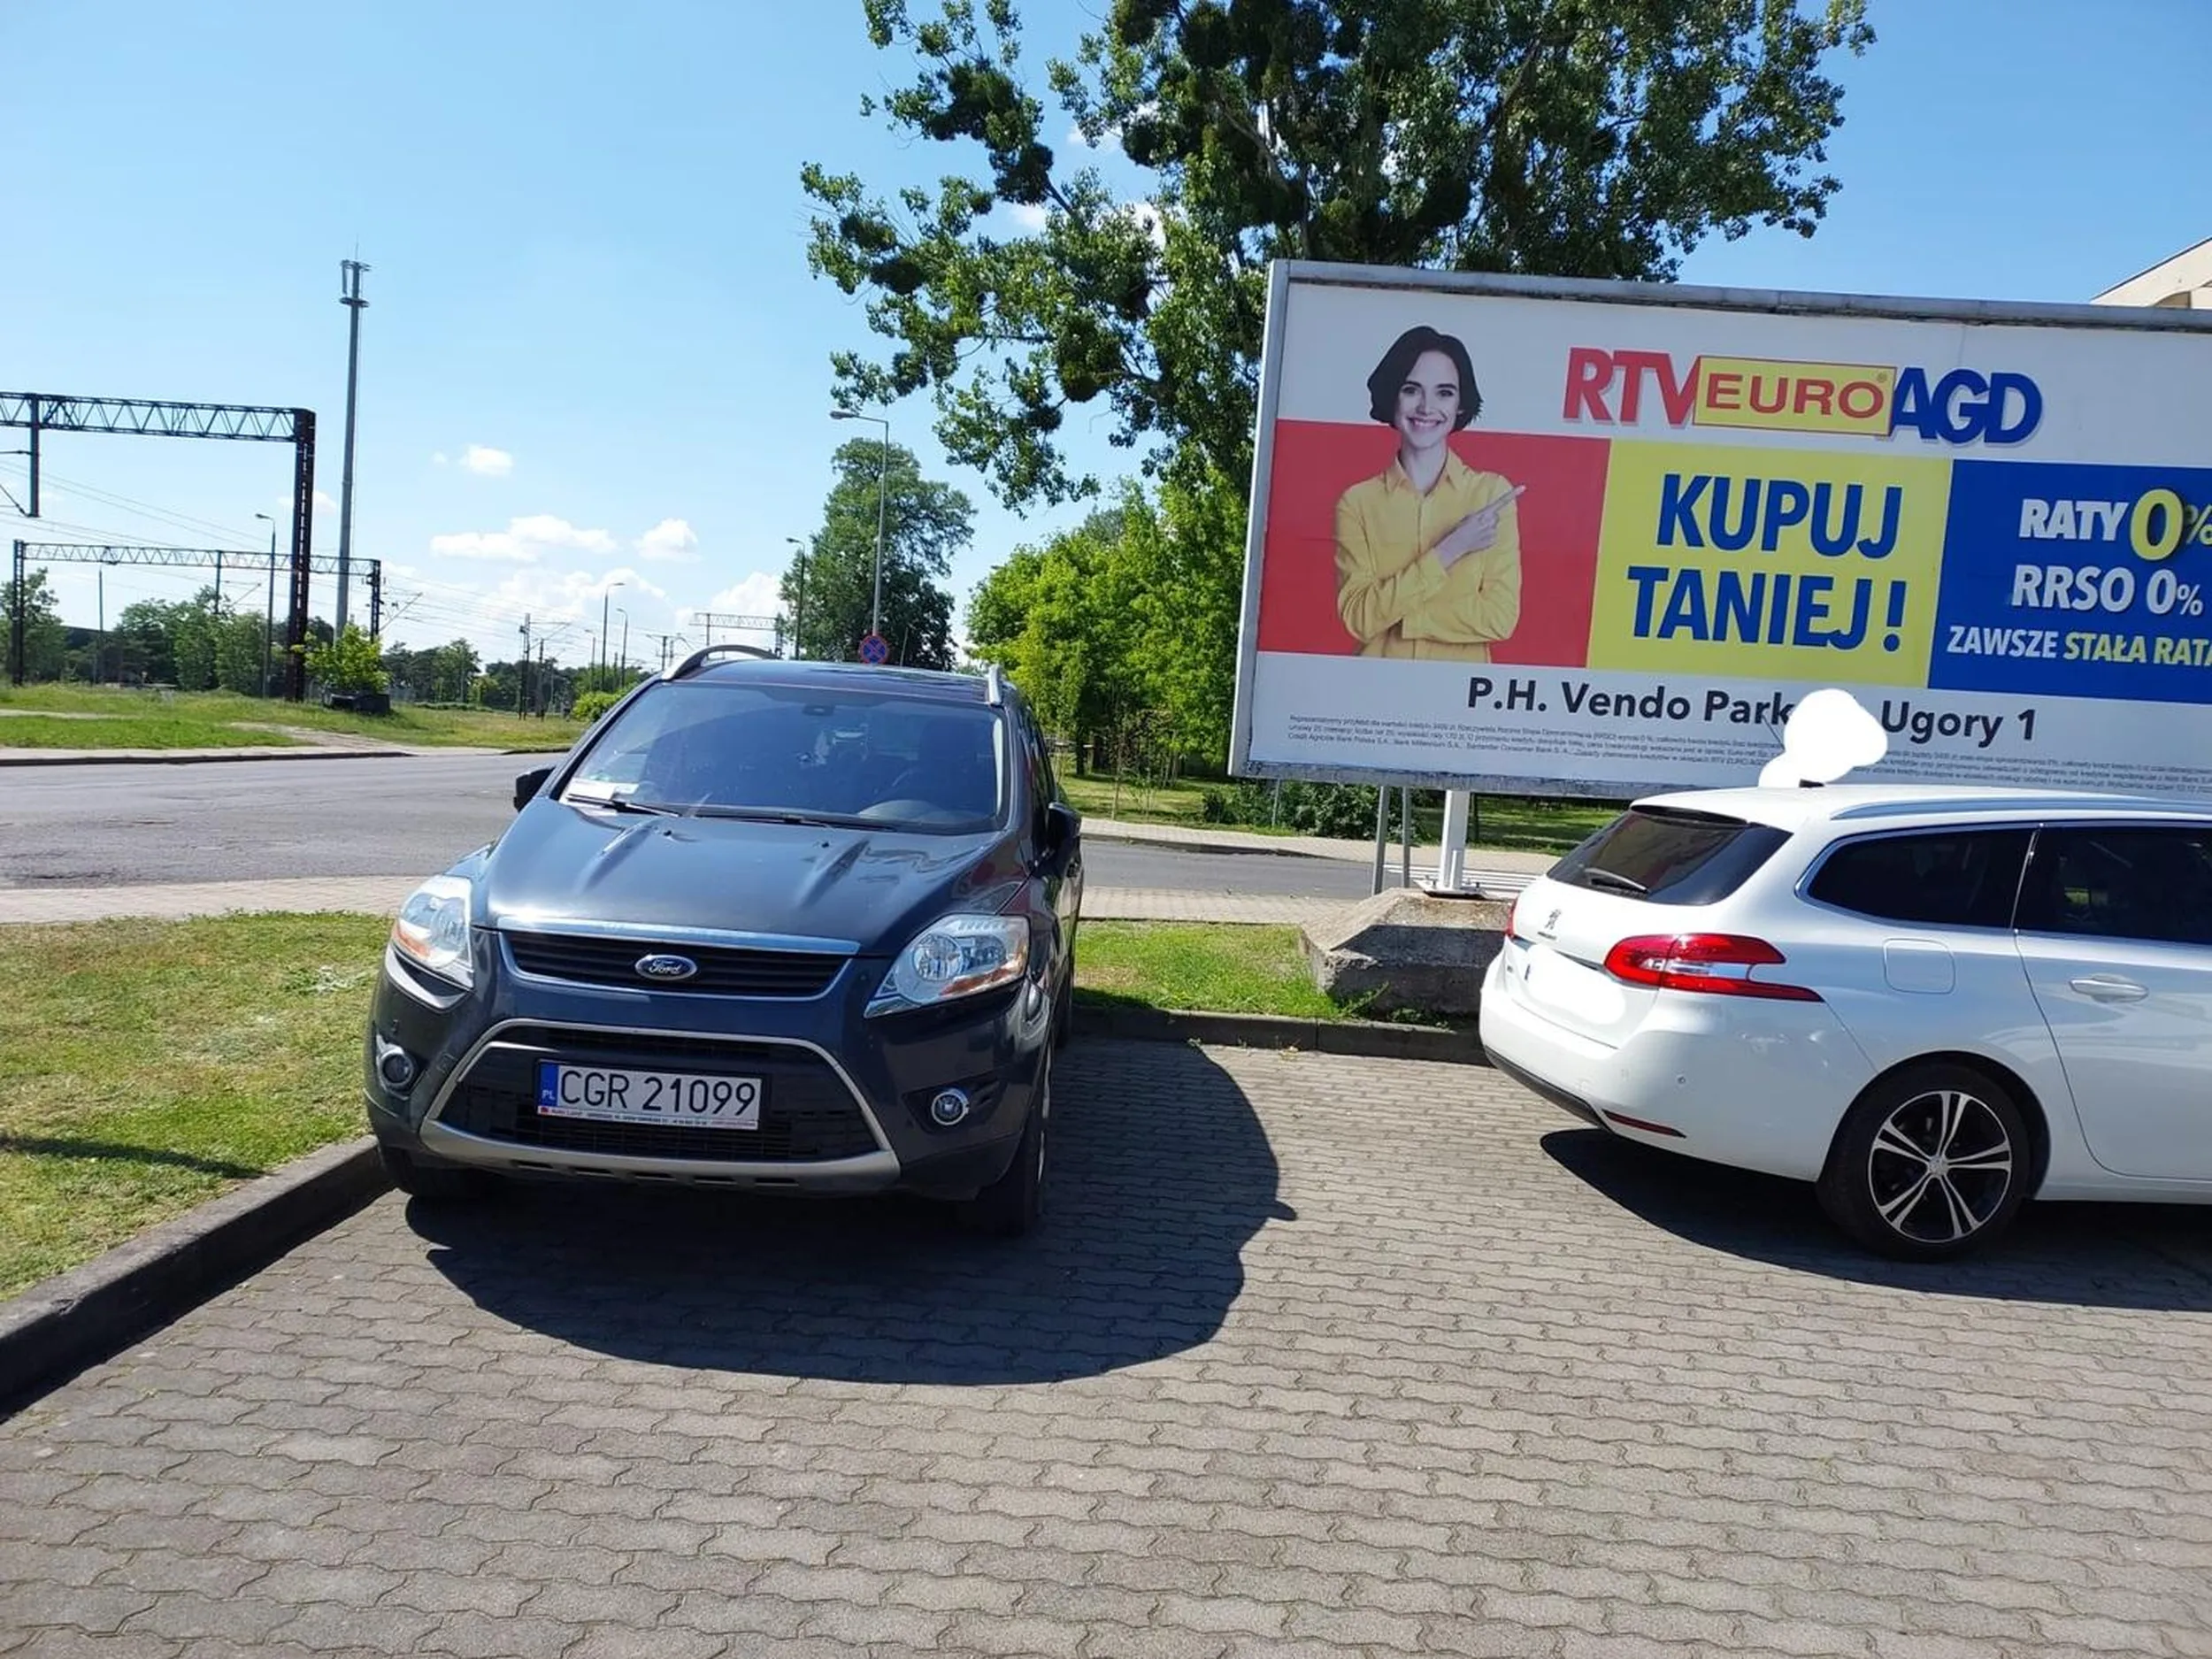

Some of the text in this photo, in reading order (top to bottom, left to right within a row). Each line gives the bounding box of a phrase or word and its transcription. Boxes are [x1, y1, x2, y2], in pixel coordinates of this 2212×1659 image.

[1563, 347, 2043, 444] RTV EURO AGD
[1656, 472, 1903, 559] KUPUJ
[2018, 498, 2129, 541] RATY
[1626, 565, 1908, 653] TANIEJ!
[2010, 564, 2204, 616] RRSO 0%
[1947, 625, 2059, 658] ZAWSZE
[2063, 630, 2147, 664] STAŁA
[1467, 676, 1548, 713] P.H.
[1561, 680, 1692, 721] Vendo
[1880, 700, 2003, 749] Ugory
[2017, 709, 2036, 741] 1
[541, 1088, 556, 1102] PL
[561, 1069, 756, 1117] CGR 21099
